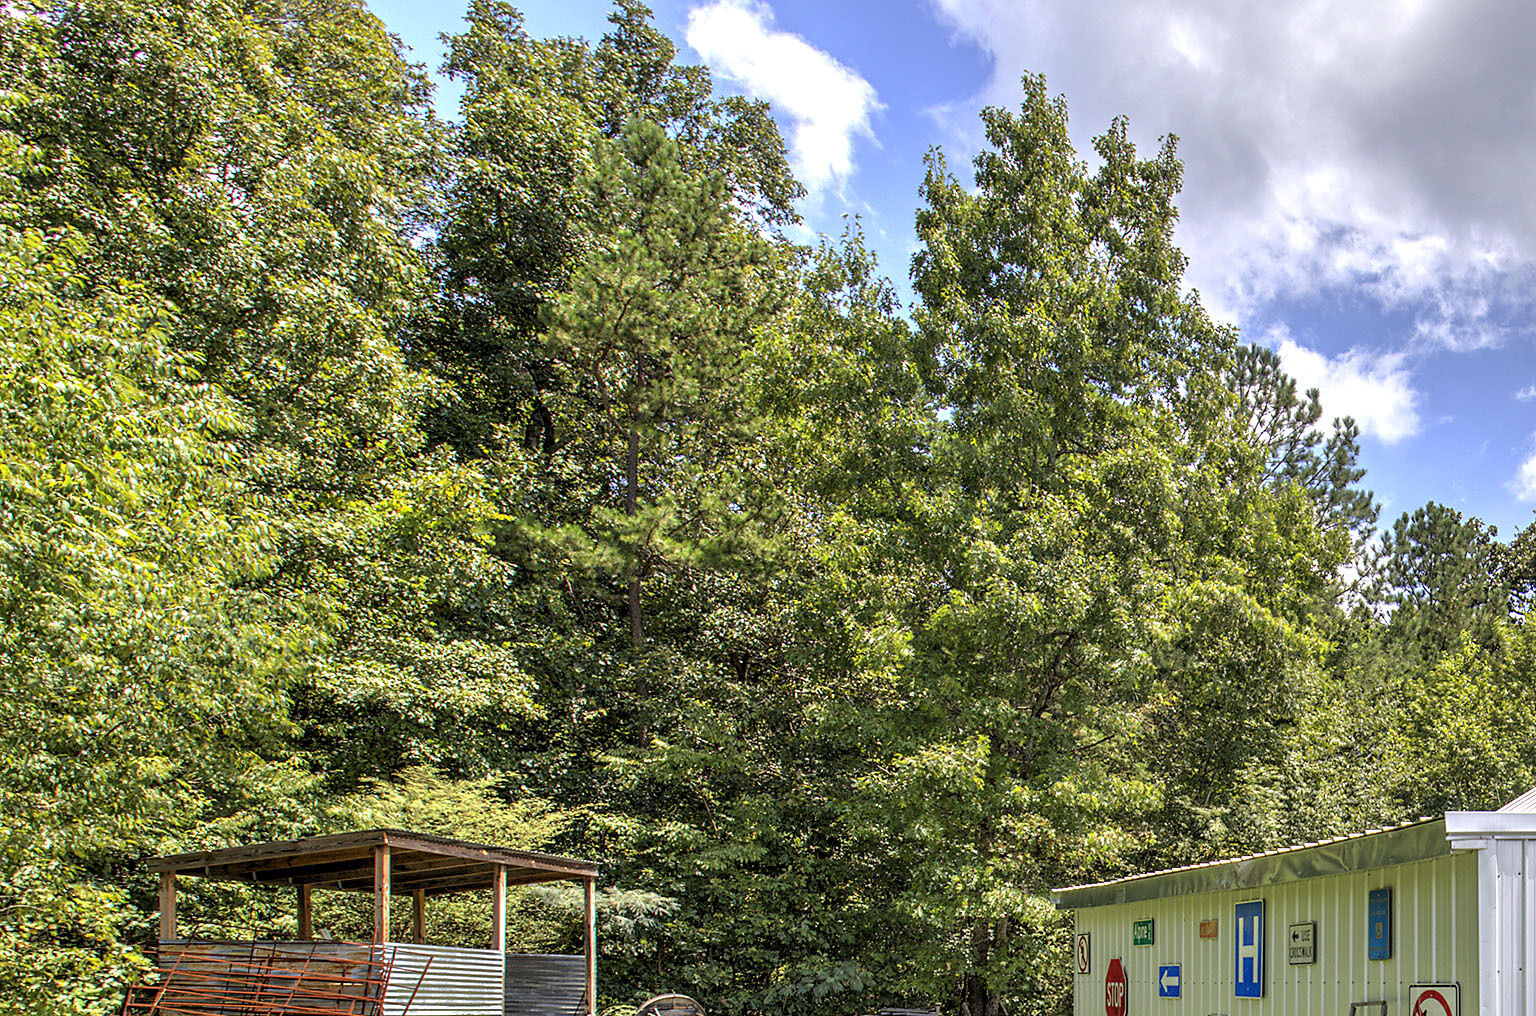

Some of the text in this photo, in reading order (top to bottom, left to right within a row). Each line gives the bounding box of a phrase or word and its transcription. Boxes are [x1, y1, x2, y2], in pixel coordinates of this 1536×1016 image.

[1302, 929, 1311, 942] USE
[1238, 915, 1259, 983] H
[1290, 946, 1312, 958] CROSSWALK
[1107, 981, 1124, 1008] STOP
